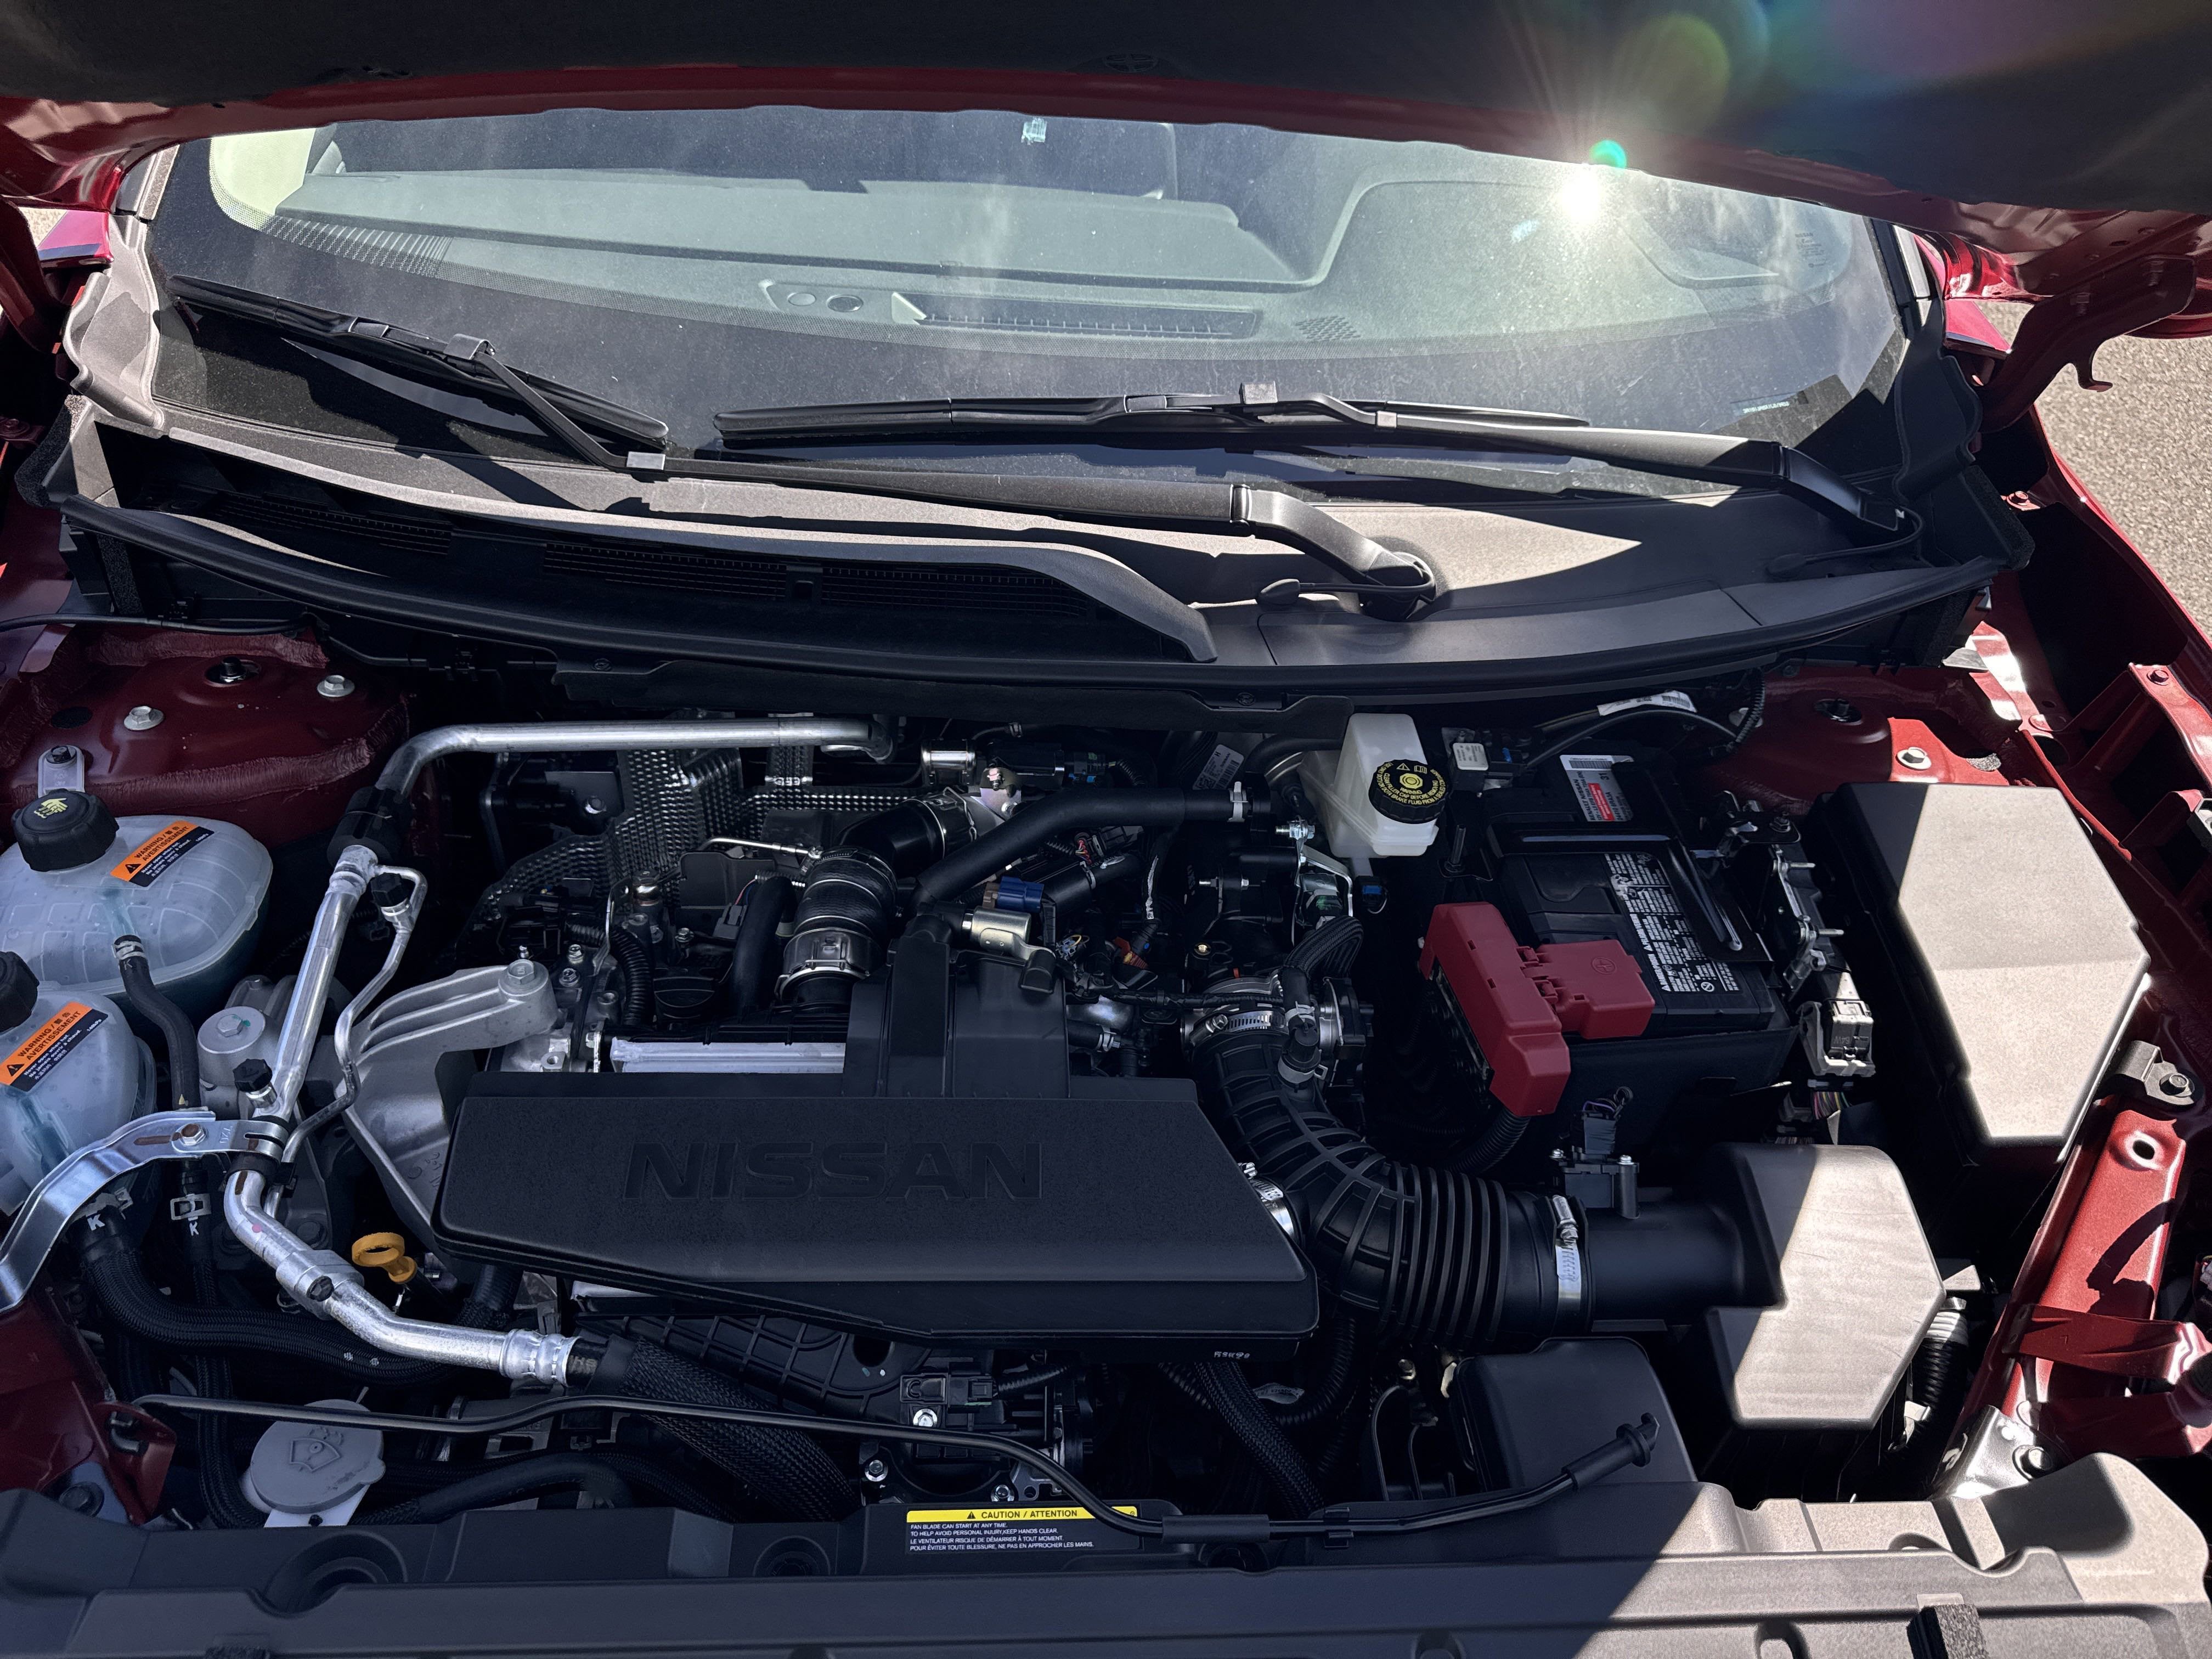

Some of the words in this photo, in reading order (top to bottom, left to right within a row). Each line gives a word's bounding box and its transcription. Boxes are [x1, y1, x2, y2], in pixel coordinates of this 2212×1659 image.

[1386, 784, 1400, 794] FILLER
[1391, 794, 1407, 803] BRAKE
[1573, 779, 1586, 799] NISSAN
[1582, 800, 1596, 821] RENAULT
[134, 835, 163, 859] WARNING
[143, 826, 189, 861] AVERTISSEMENT
[123, 958, 133, 970] K
[18, 1028, 52, 1057] WARNING
[26, 1011, 81, 1060] AVERTISSEMENT
[24, 1063, 37, 1075] Never
[38, 1053, 49, 1063] open
[49, 1042, 61, 1053] when
[37, 1058, 51, 1071] jamais
[50, 1046, 64, 1057] ouvrir
[622, 1142, 1043, 1200] NISSAN
[87, 1214, 105, 1231] K
[189, 1221, 199, 1236] K
[981, 1511, 1020, 1519] CAUTION
[1030, 1510, 1077, 1518] ATTENTION
